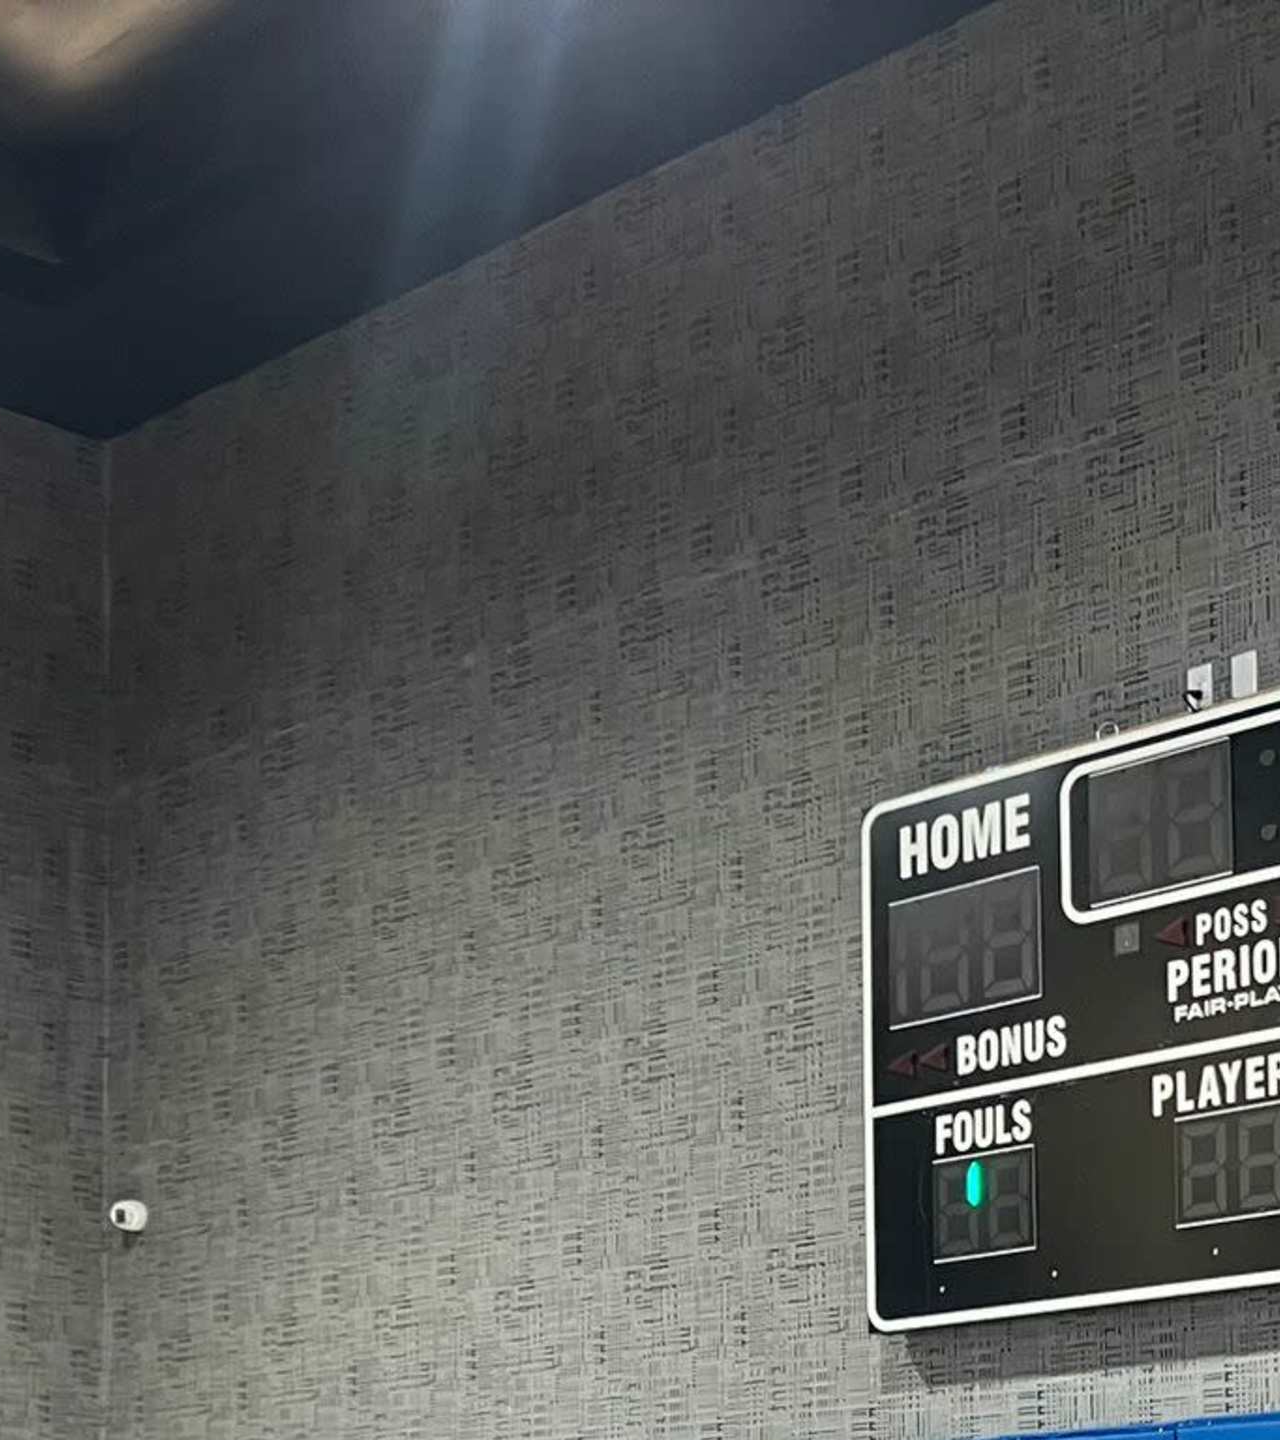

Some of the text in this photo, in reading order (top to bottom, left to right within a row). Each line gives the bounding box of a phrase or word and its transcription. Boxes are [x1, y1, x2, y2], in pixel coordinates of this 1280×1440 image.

[899, 793, 1031, 879] HOME
[1195, 899, 1268, 946] POSS
[956, 1015, 1067, 1076] BONUS
[935, 1100, 1033, 1155] FOULS
